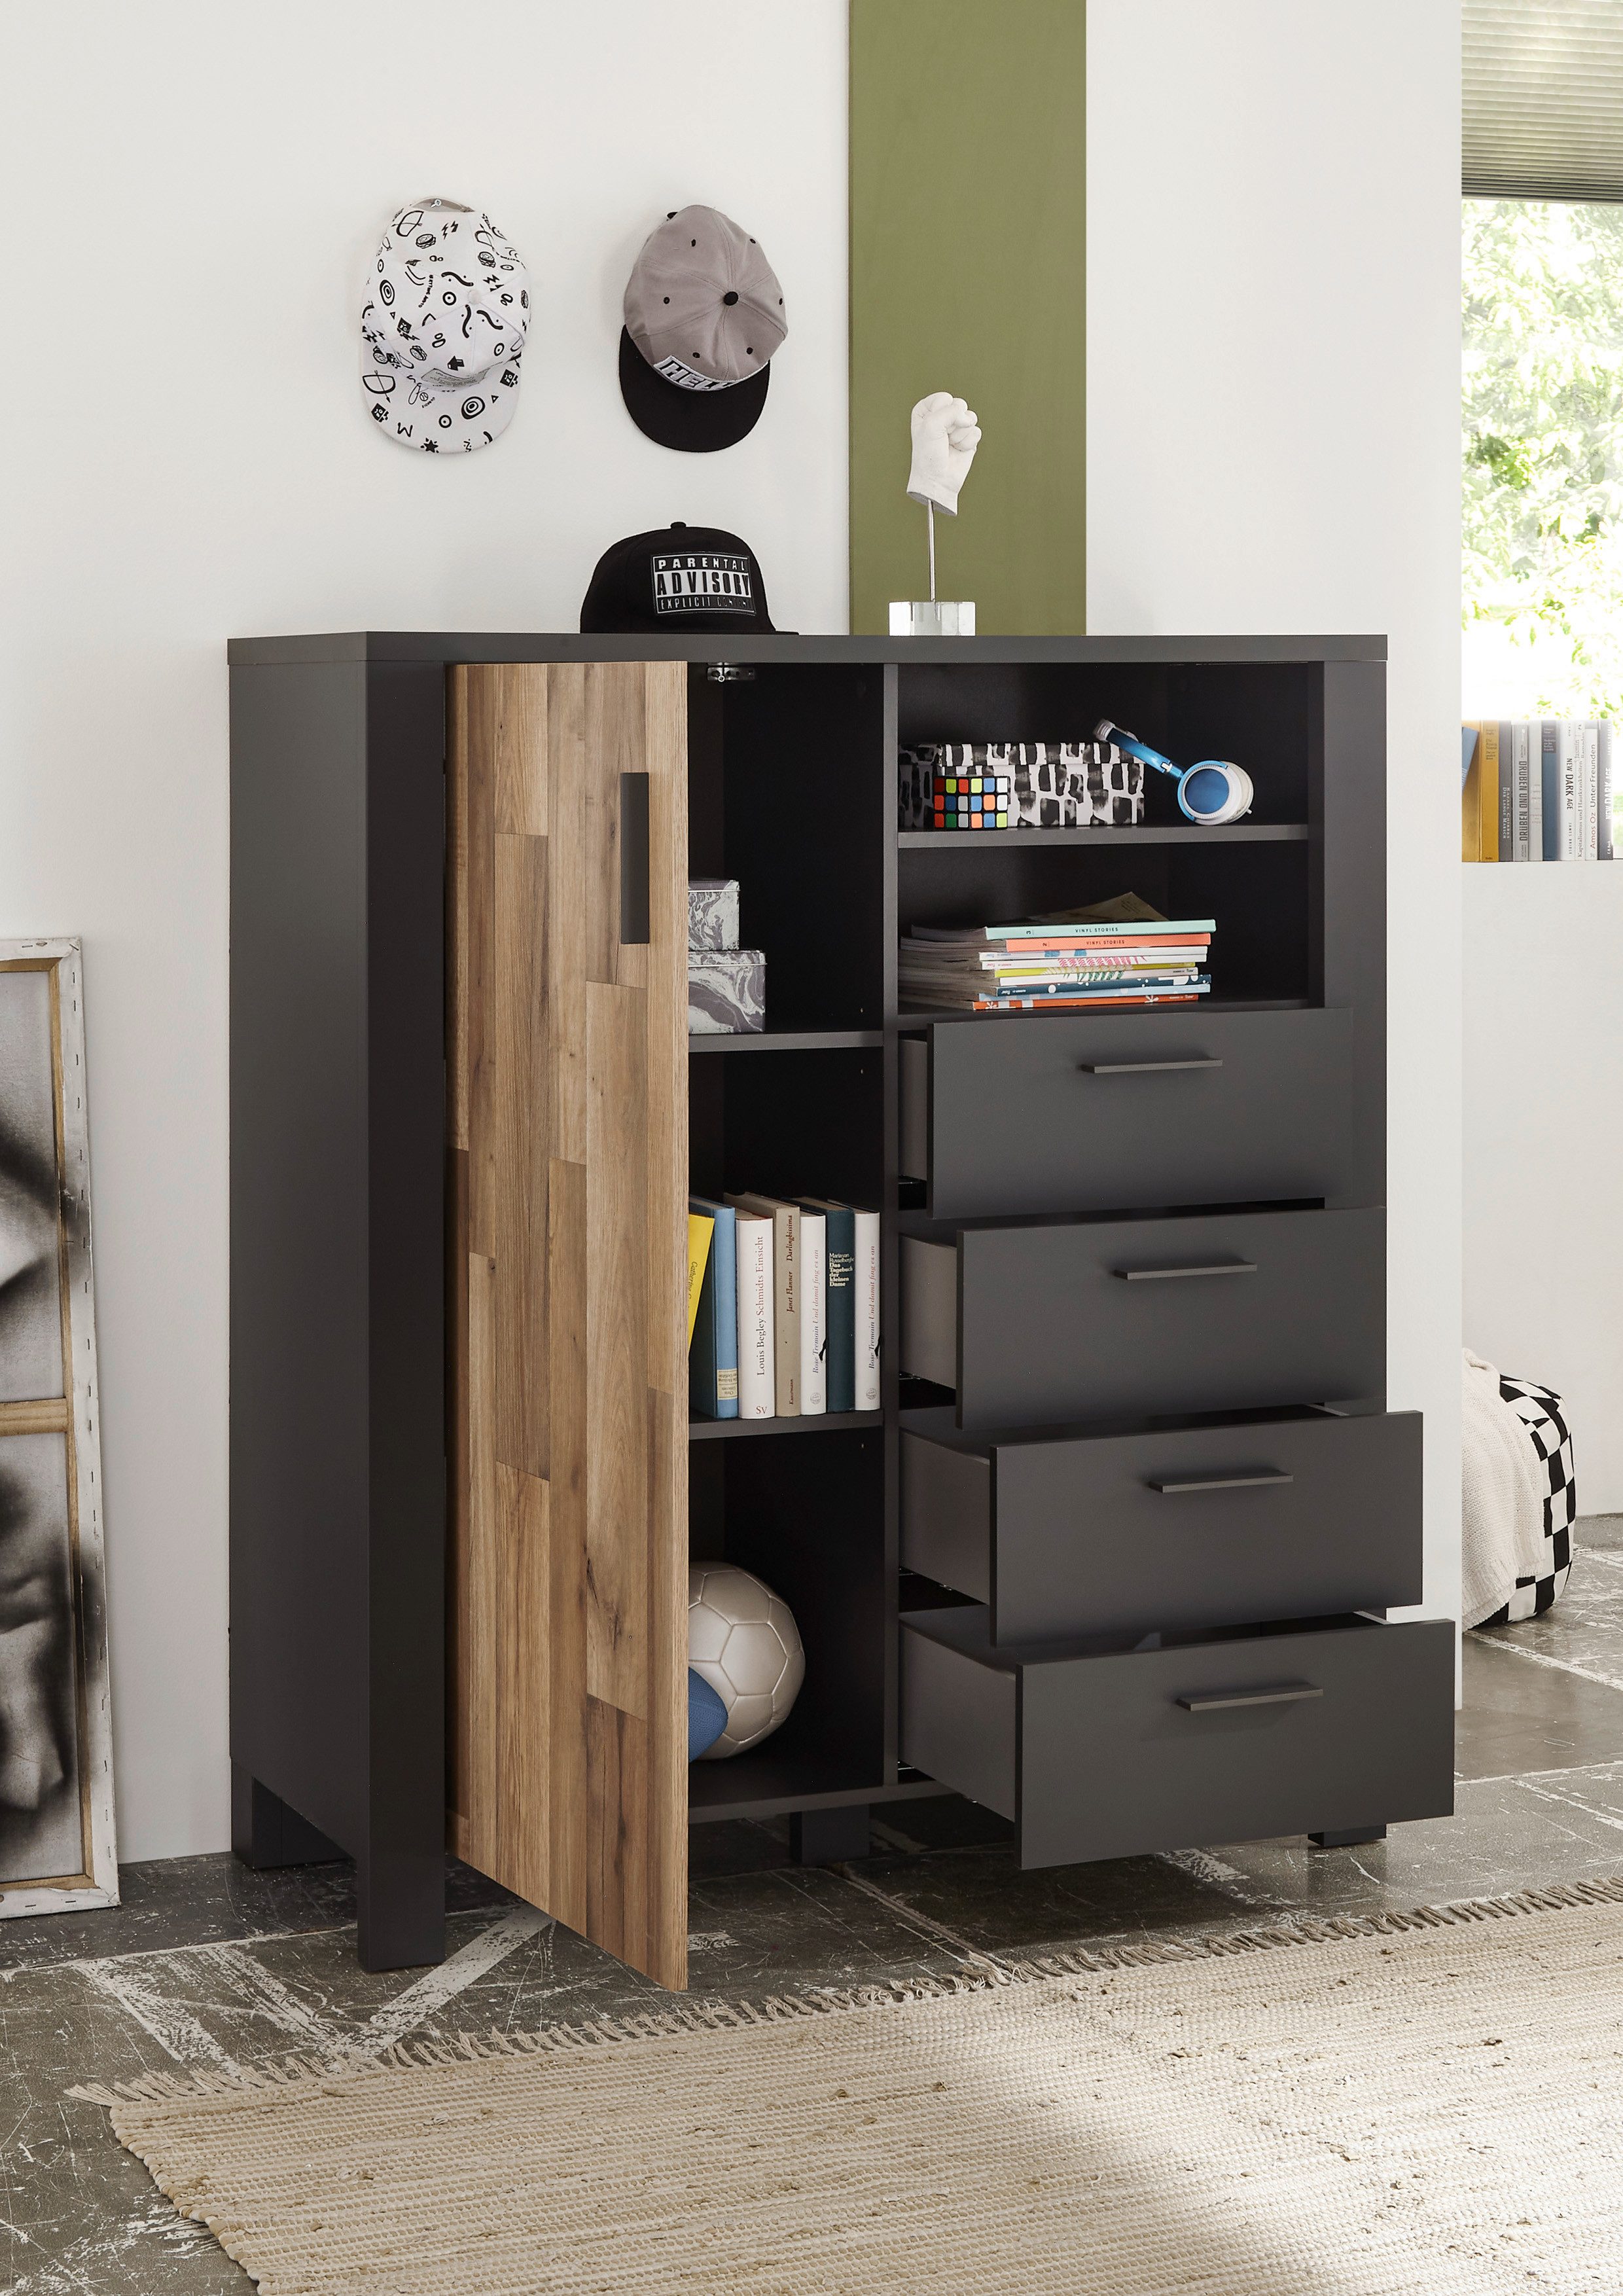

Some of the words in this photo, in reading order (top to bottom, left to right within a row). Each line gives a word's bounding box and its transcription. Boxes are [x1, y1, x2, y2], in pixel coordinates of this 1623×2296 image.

[658, 557, 745, 571] PARENTAL
[657, 571, 749, 596] ADVISORY
[661, 596, 711, 610] EXPLICIT
[1590, 812, 1596, 823] Oz
[755, 1236, 764, 1272] Einsicht
[813, 1249, 819, 1259] an
[870, 1246, 874, 1255] an
[756, 1276, 764, 1316] Schmidts
[786, 1297, 794, 1314] Janet
[757, 1318, 766, 1348] Begley
[756, 1405, 767, 1414] SV
